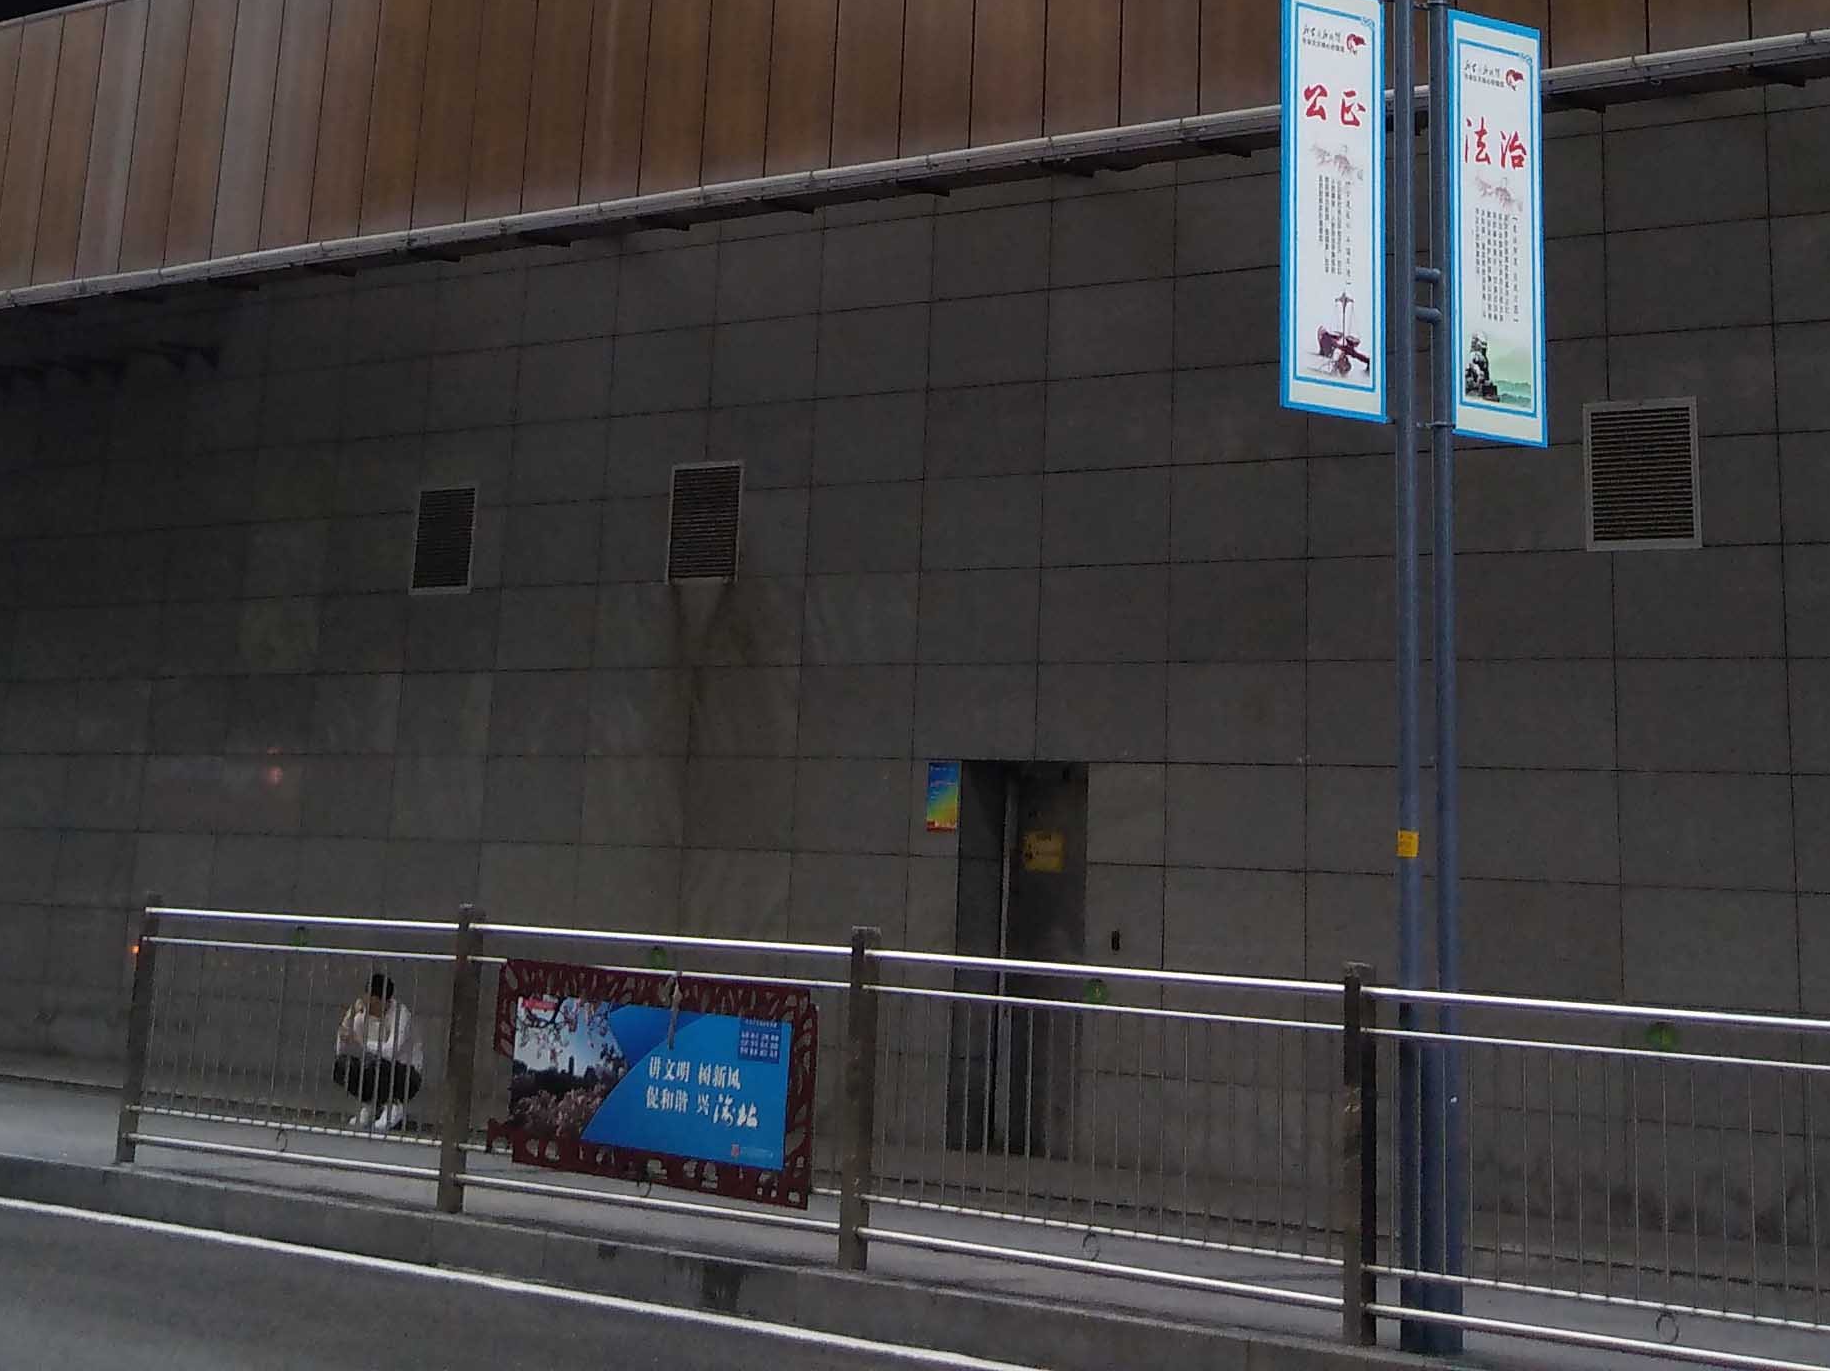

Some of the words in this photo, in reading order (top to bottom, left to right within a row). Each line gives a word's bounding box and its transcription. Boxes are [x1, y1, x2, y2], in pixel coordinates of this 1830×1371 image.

[1303, 83, 1367, 127] 公正
[1464, 115, 1528, 170] 法治
[648, 1054, 691, 1083] 讲文明
[697, 1062, 742, 1091] 树新风
[645, 1084, 690, 1114] 促和谐
